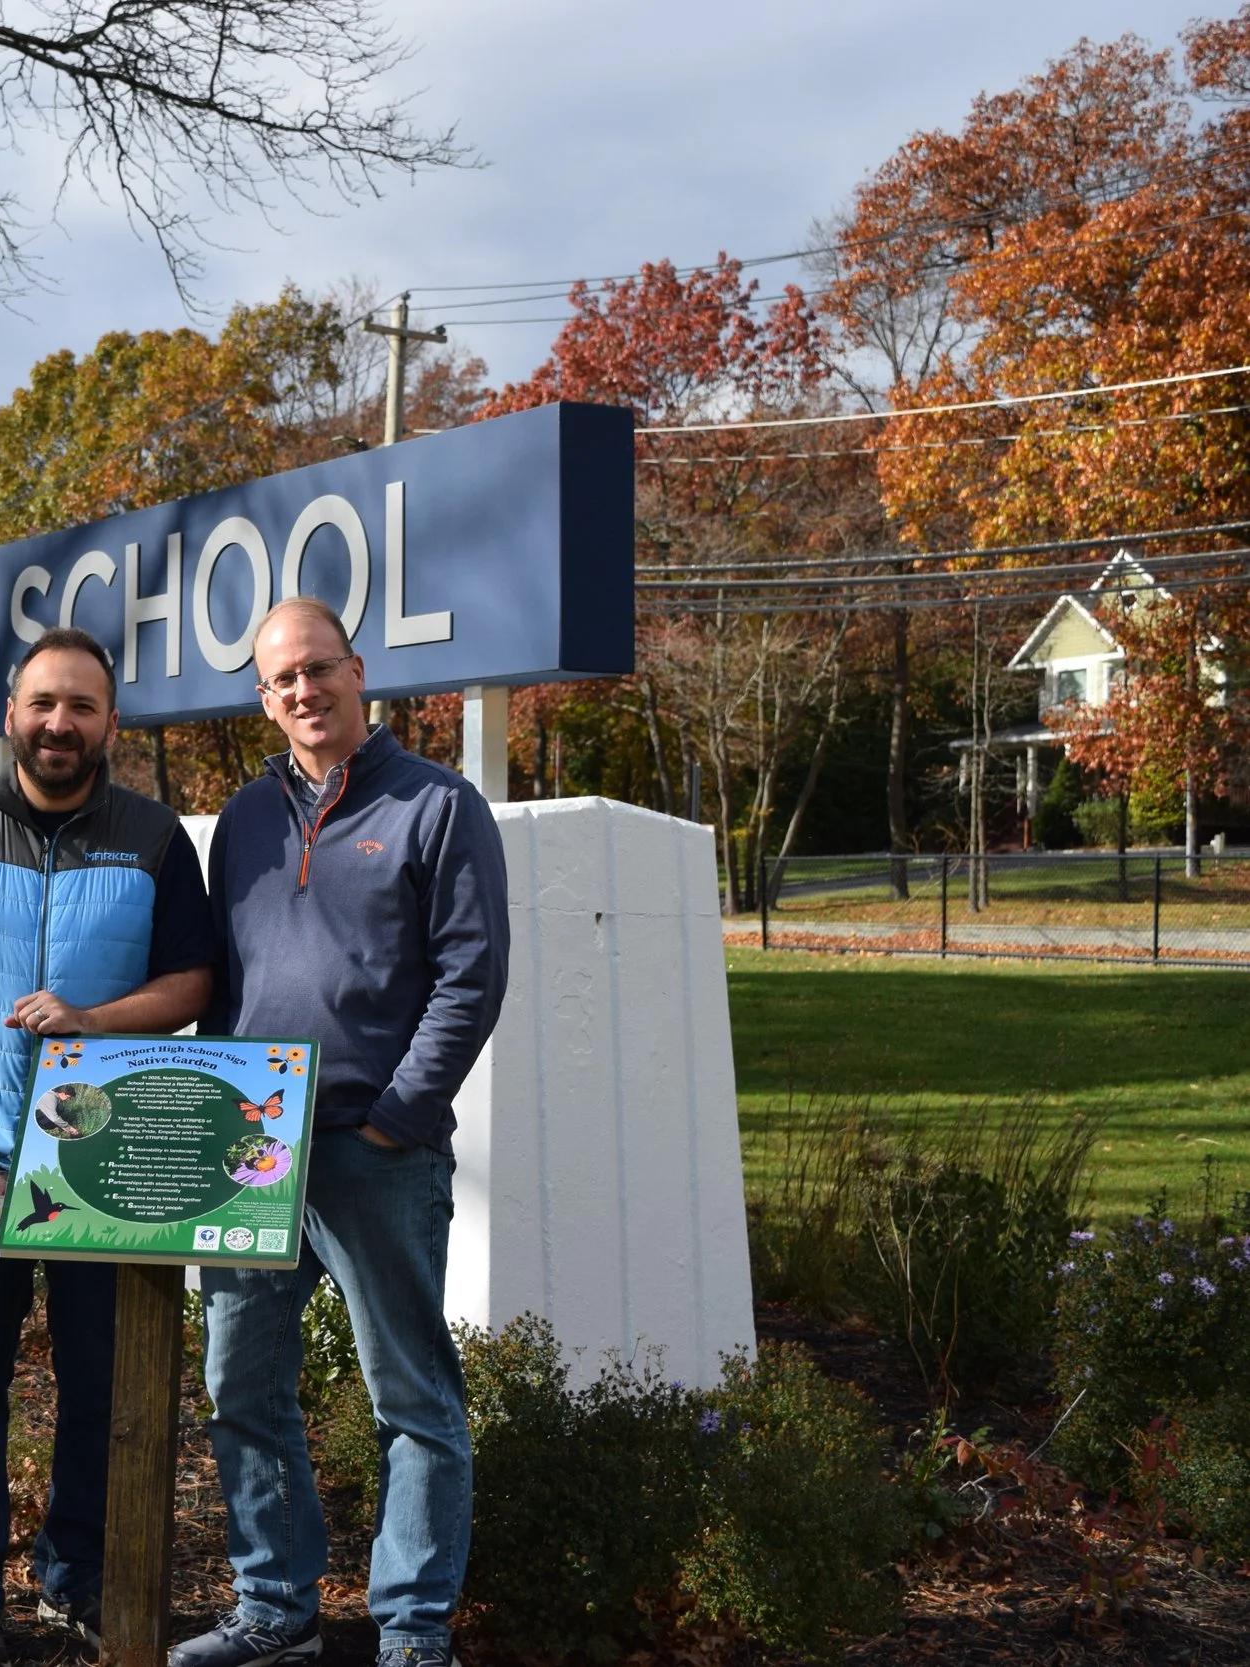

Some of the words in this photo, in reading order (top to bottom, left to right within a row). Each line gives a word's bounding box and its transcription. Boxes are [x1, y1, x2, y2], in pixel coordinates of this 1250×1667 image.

[7, 481, 453, 689] SCHOOL
[85, 852, 139, 862] MARKER
[100, 1046, 155, 1062] Northport
[158, 1045, 184, 1054] High
[187, 1046, 224, 1059] School
[224, 1053, 247, 1066] Sign
[128, 1056, 169, 1068] Native
[171, 1055, 218, 1071] Garden
[118, 1170, 146, 1178] Inspiration
[108, 1178, 142, 1186] Partnerships
[112, 1193, 145, 1201] Ecosystems
[127, 1202, 156, 1210] Sanctuary
